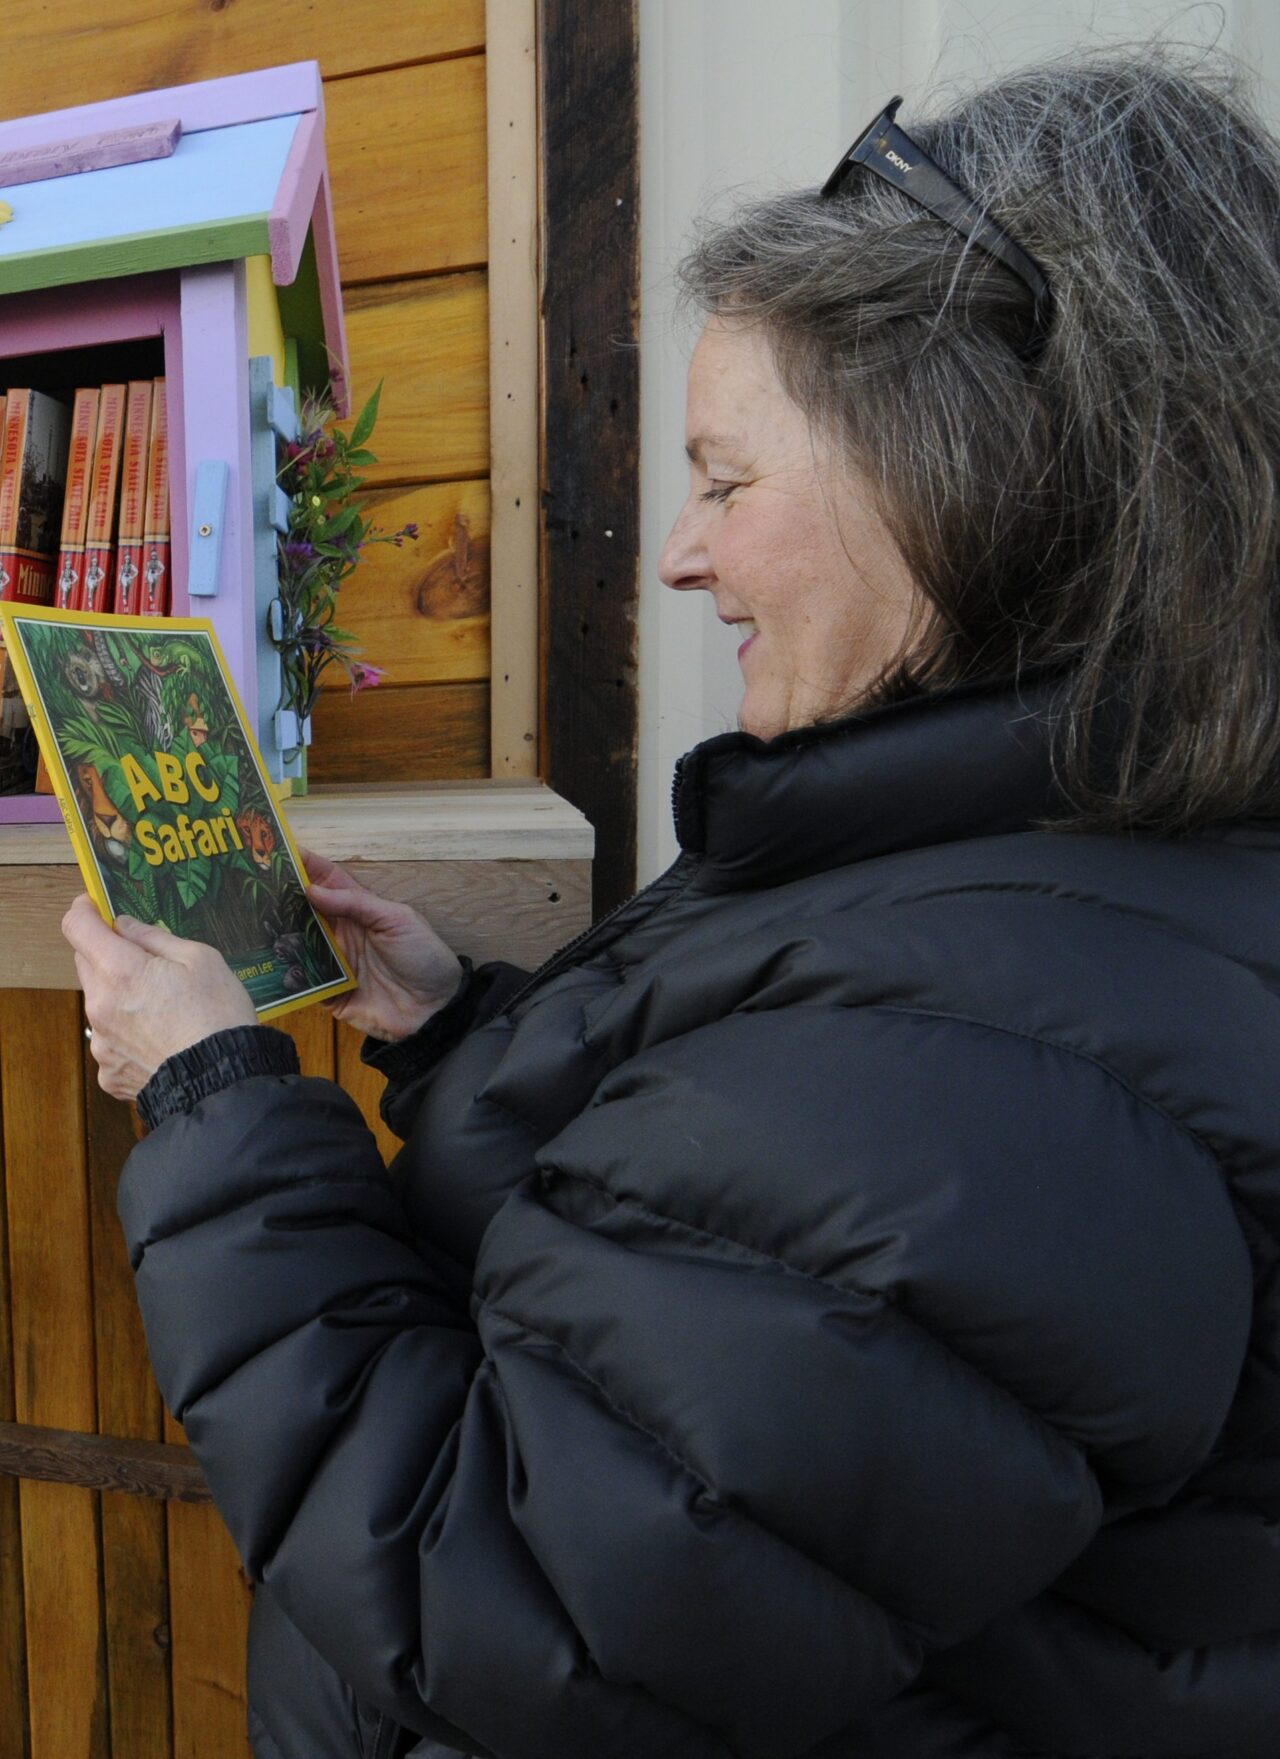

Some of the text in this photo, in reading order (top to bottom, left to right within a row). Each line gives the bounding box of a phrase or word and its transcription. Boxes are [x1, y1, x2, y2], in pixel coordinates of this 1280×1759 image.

[885, 150, 913, 173] DKNY
[6, 401, 20, 464] MINNESOTA
[100, 396, 117, 459] MINNESOTA
[129, 393, 145, 456] MINNESOTA
[2, 468, 15, 500] STATE
[68, 401, 91, 530] MINNESOTA STATE FAIR
[97, 465, 111, 496] STATE
[127, 461, 140, 493] STATE
[121, 751, 220, 813] ABC
[135, 807, 244, 866] Safari
[257, 961, 274, 974] Lee
